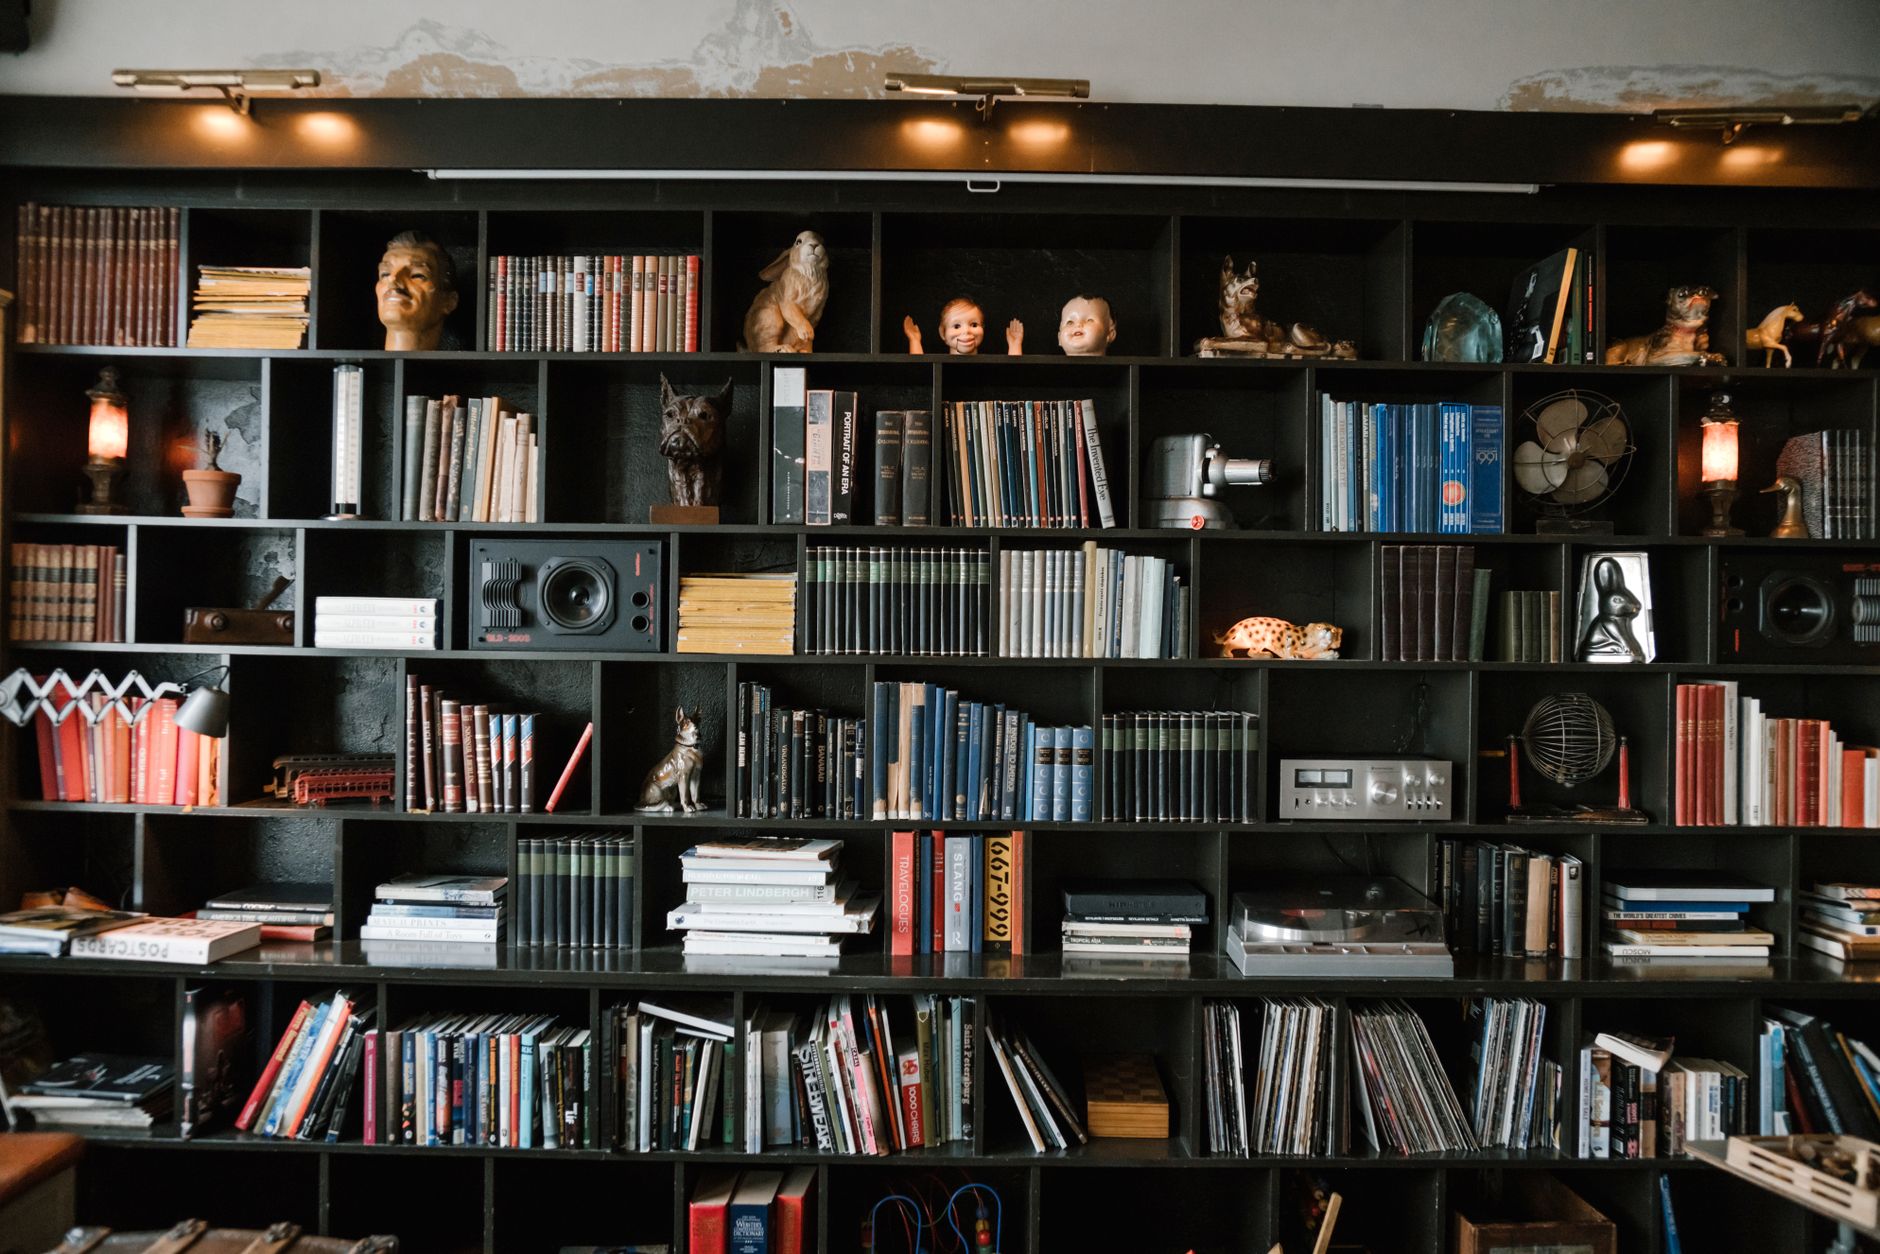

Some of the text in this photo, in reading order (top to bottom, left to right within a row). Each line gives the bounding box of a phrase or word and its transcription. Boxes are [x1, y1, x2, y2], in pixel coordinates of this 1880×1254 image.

[841, 411, 852, 495] PORTRAIT OF AN ERA
[1087, 425, 1108, 501] The Invented Eye
[738, 731, 746, 746] JEAN
[738, 746, 746, 767] RENOIR
[1007, 715, 1018, 792] MY BRIDGE TO AMERICA
[690, 887, 809, 898] PETER LINDBERGH
[899, 855, 909, 934] TRAVELOGUES
[953, 853, 963, 902] SLANG
[77, 937, 170, 959] POSTCARDS
[962, 1024, 972, 1105] Saint Petersburg
[909, 1086, 920, 1143] 1000 CHAIRS
